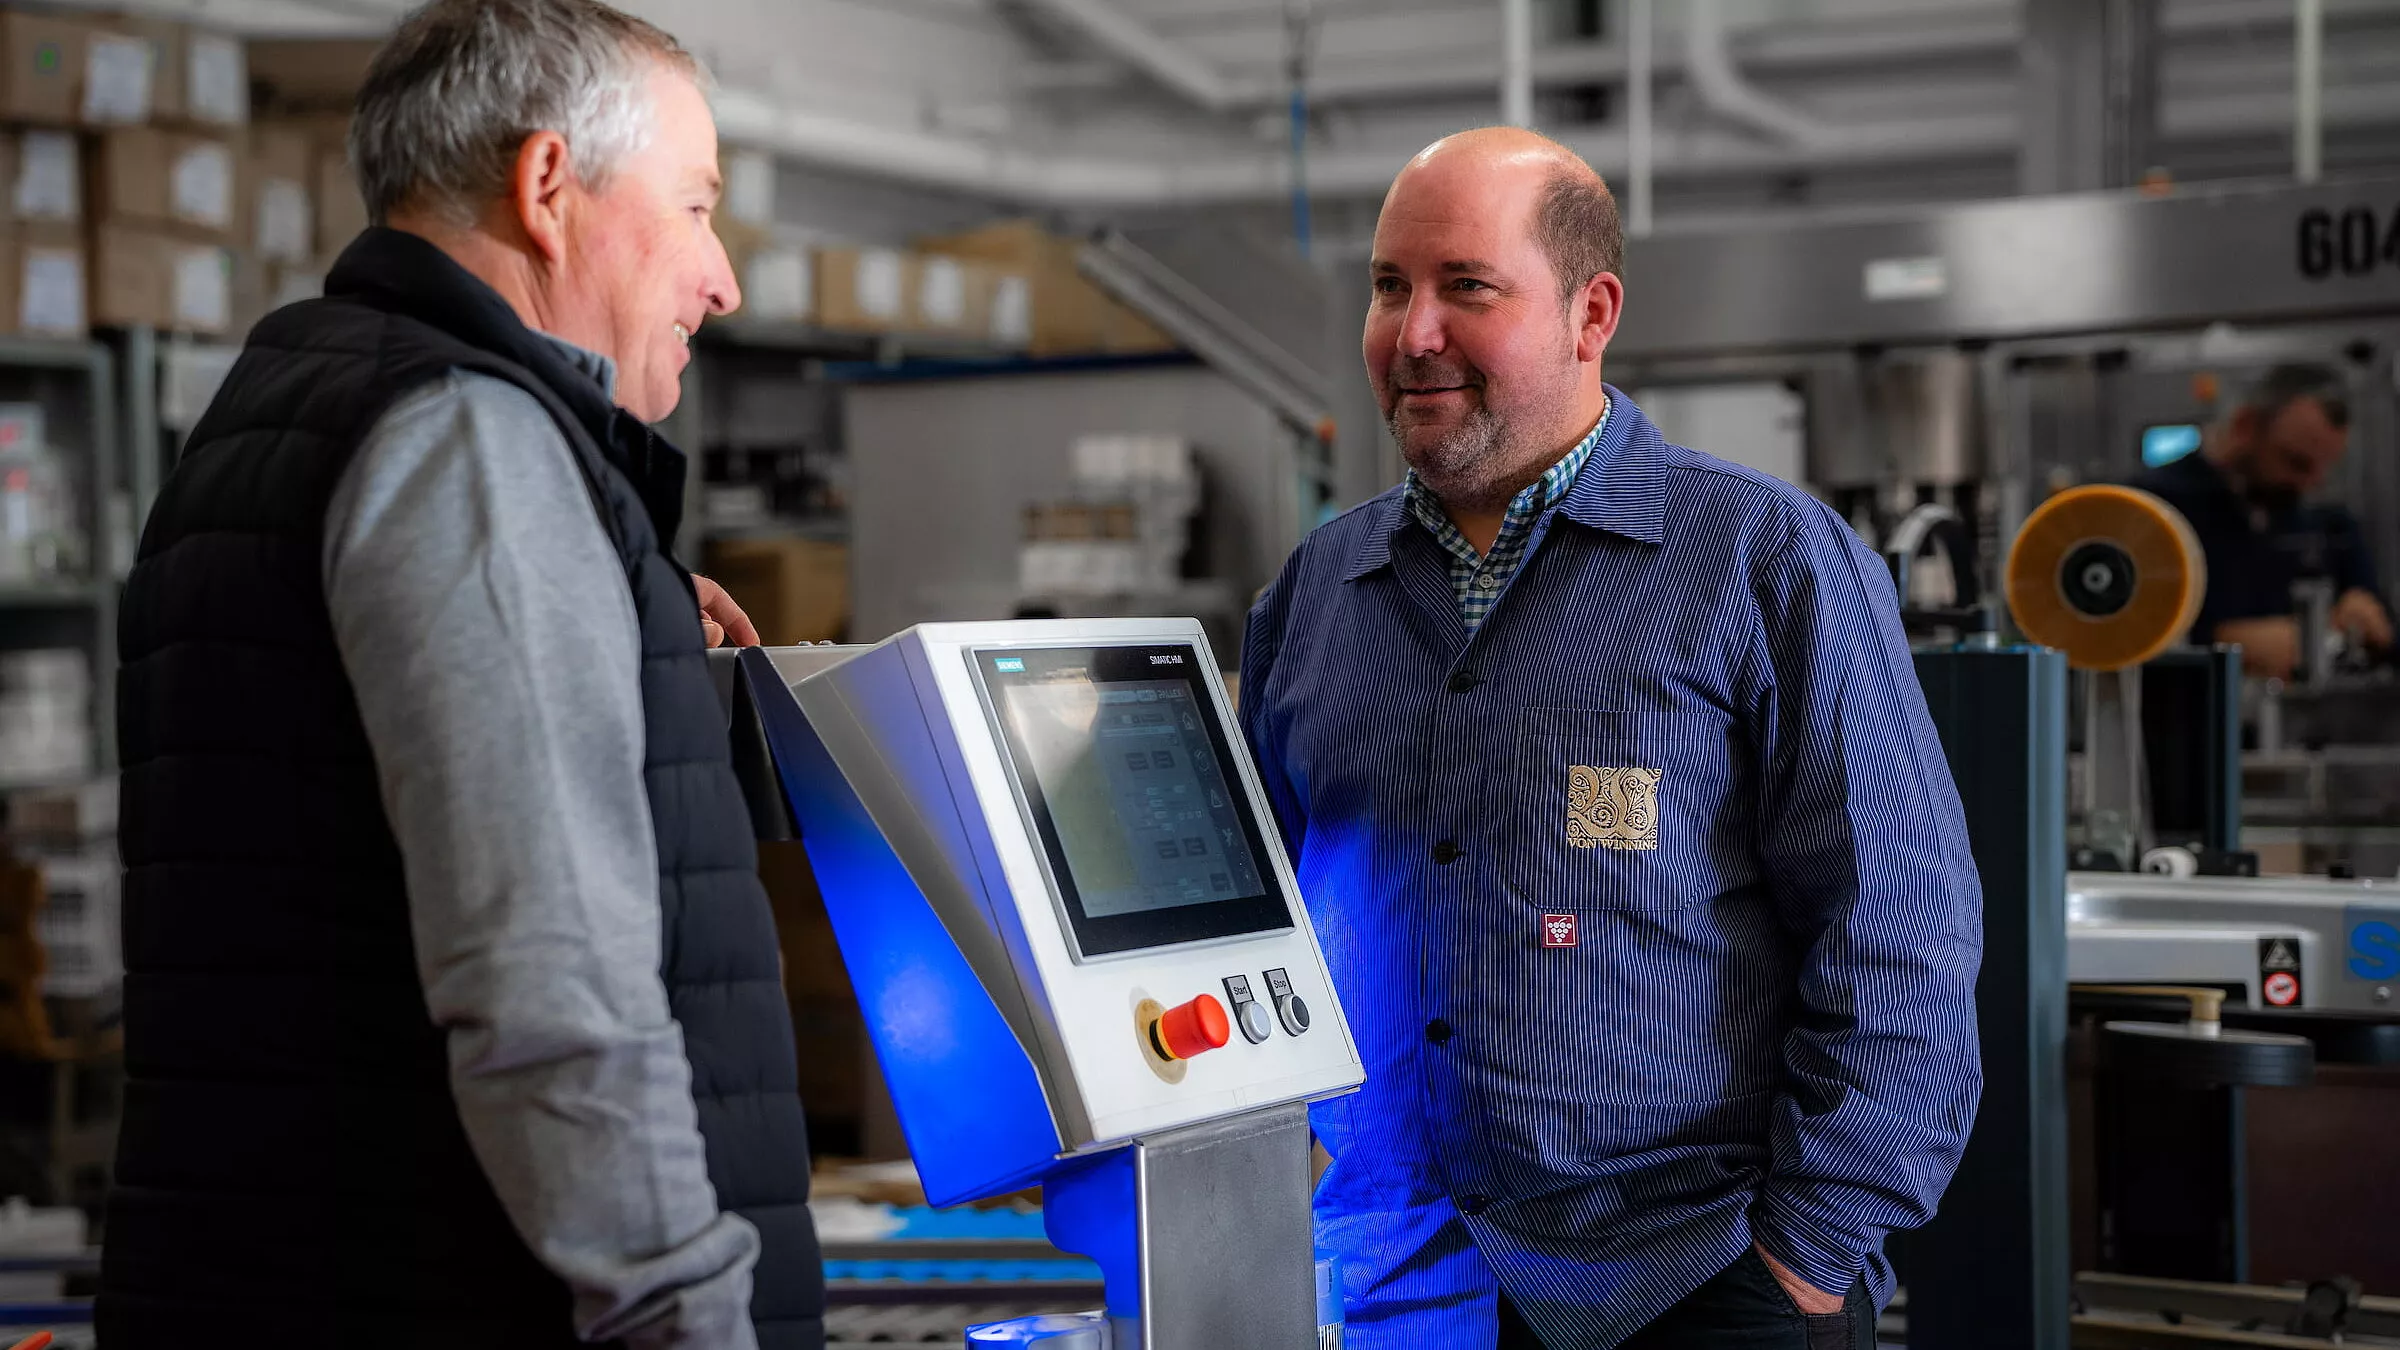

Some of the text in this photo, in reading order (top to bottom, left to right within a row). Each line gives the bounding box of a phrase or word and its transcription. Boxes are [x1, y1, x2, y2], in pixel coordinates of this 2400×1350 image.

[1567, 837, 1658, 850] VON WINNING
[1273, 979, 1287, 989] Stop
[1233, 985, 1248, 995] Start
